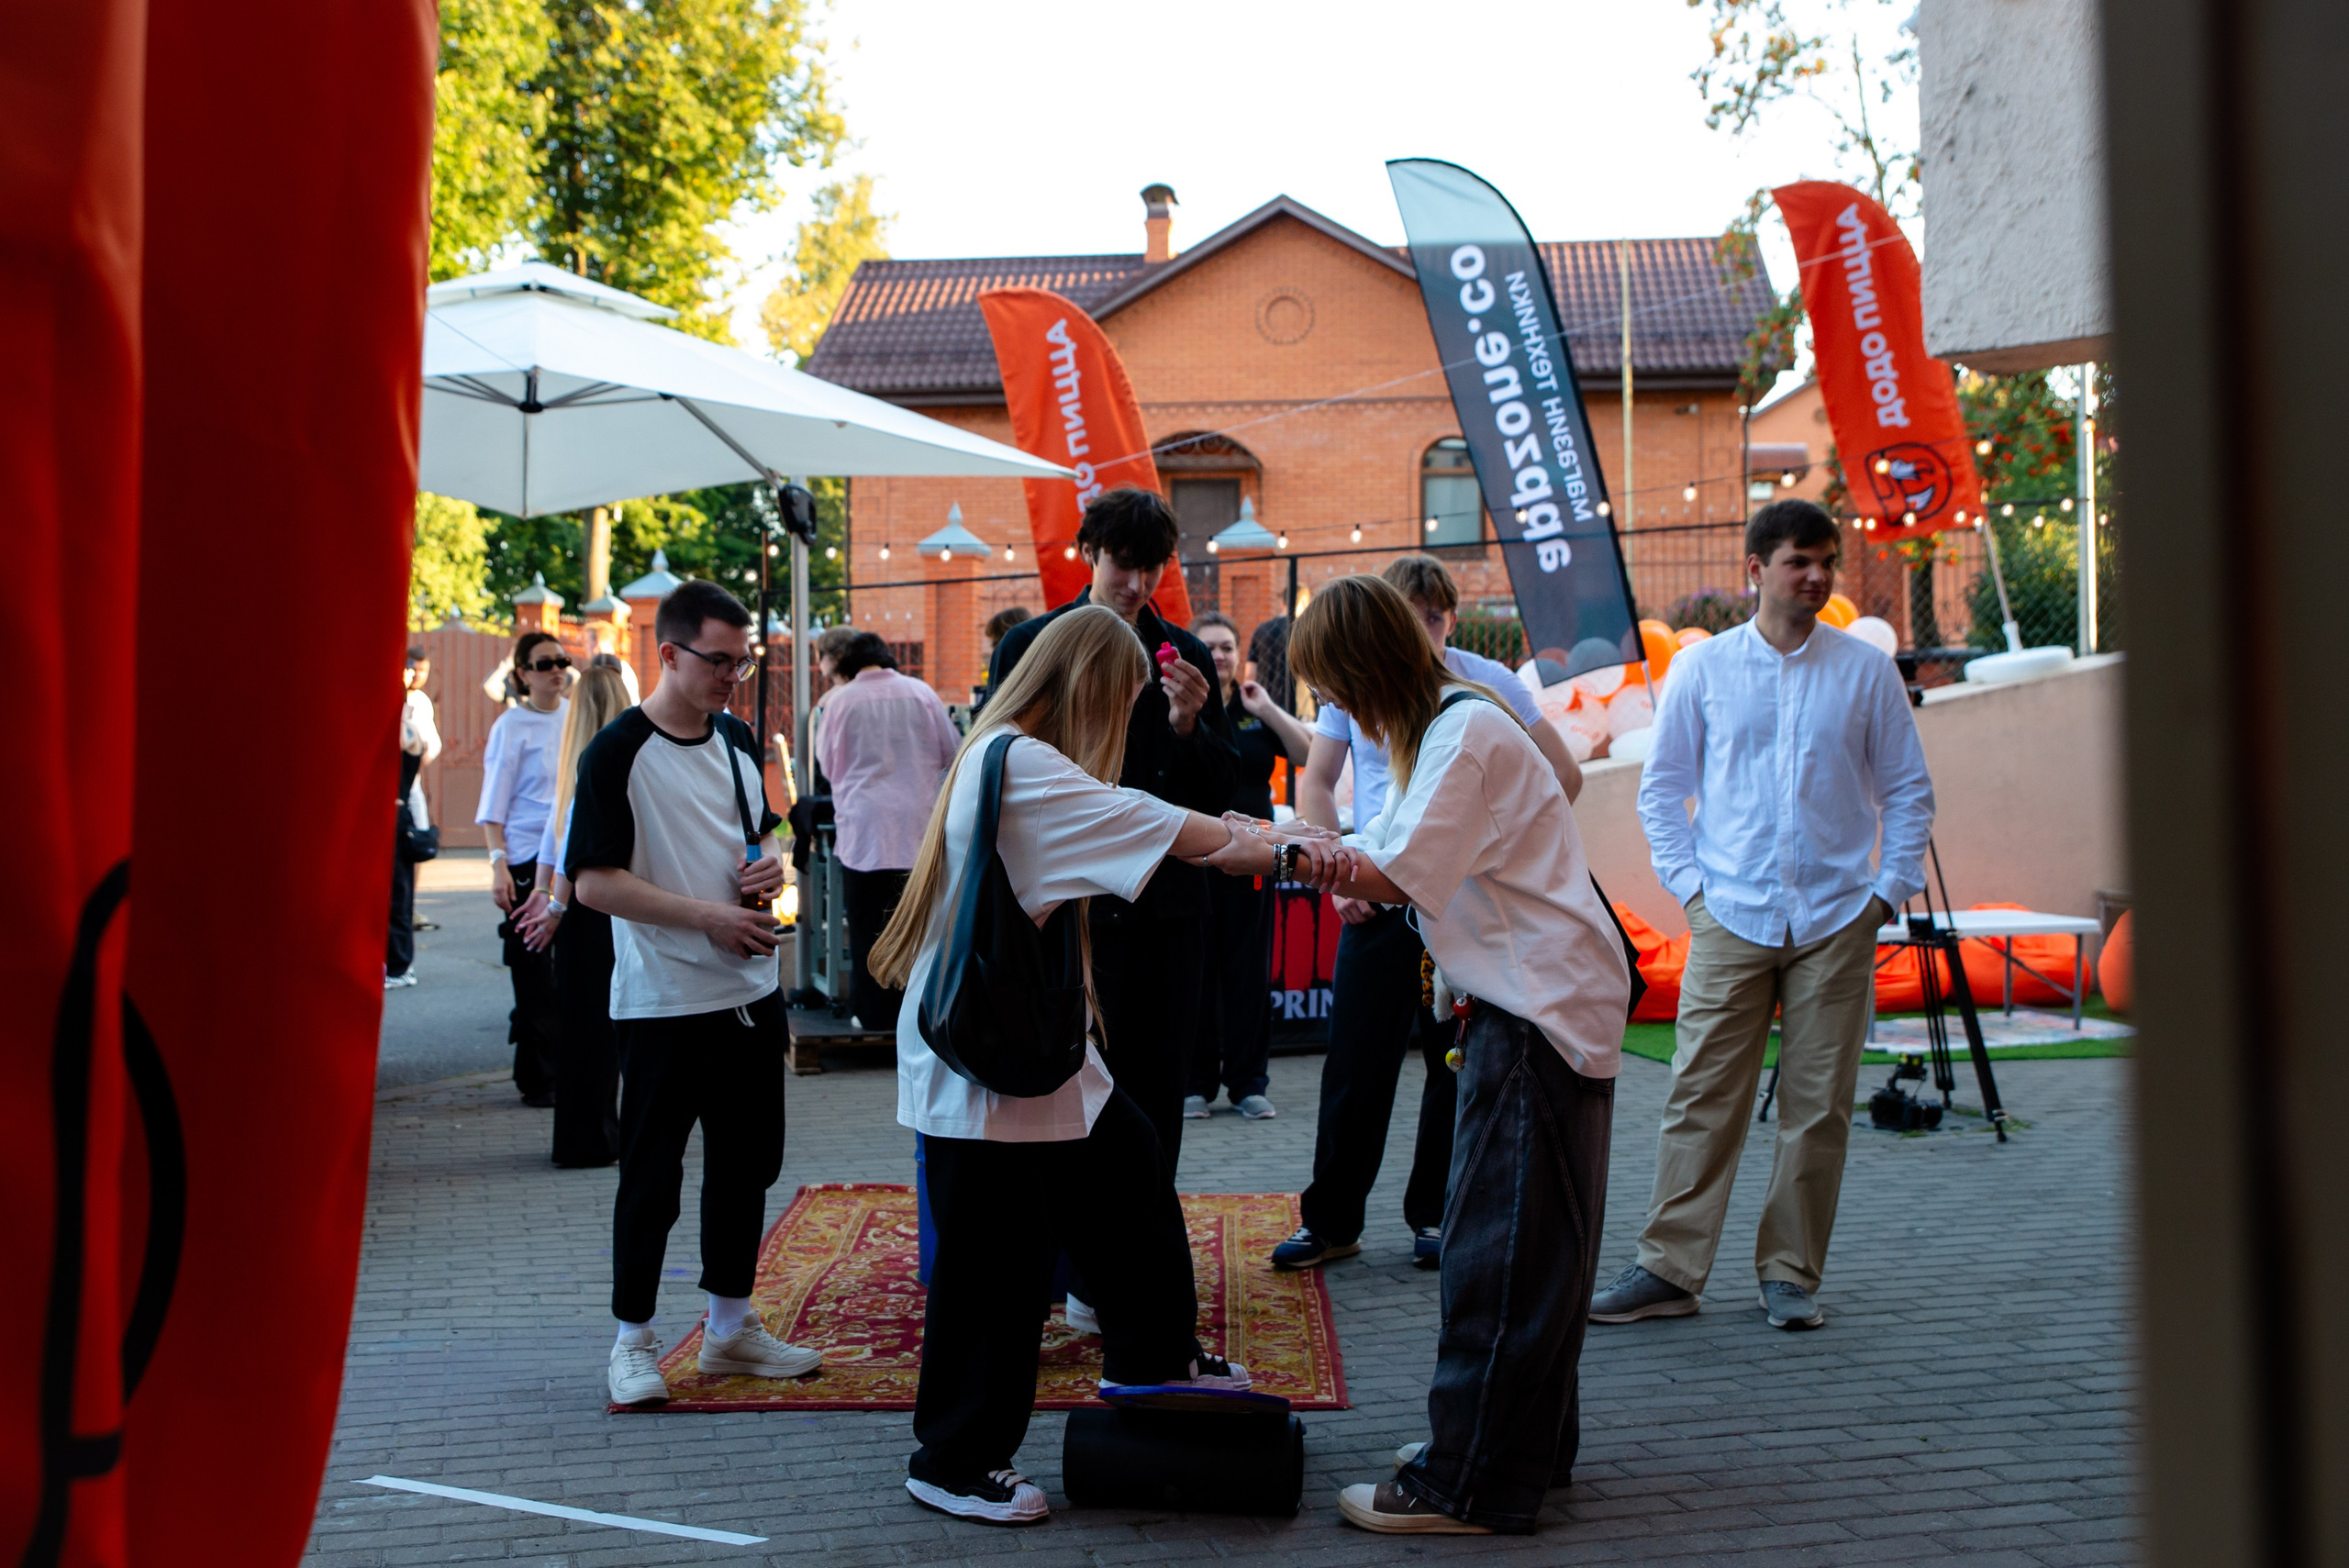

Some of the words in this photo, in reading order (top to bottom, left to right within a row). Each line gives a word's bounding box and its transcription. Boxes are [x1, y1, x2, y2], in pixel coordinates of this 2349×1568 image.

[1836, 202, 1882, 330] ПИЦЦА
[1045, 318, 1090, 458] ПИЦЦА
[1861, 331, 1910, 428] ДОДО
[1074, 462, 1104, 514] ДО
